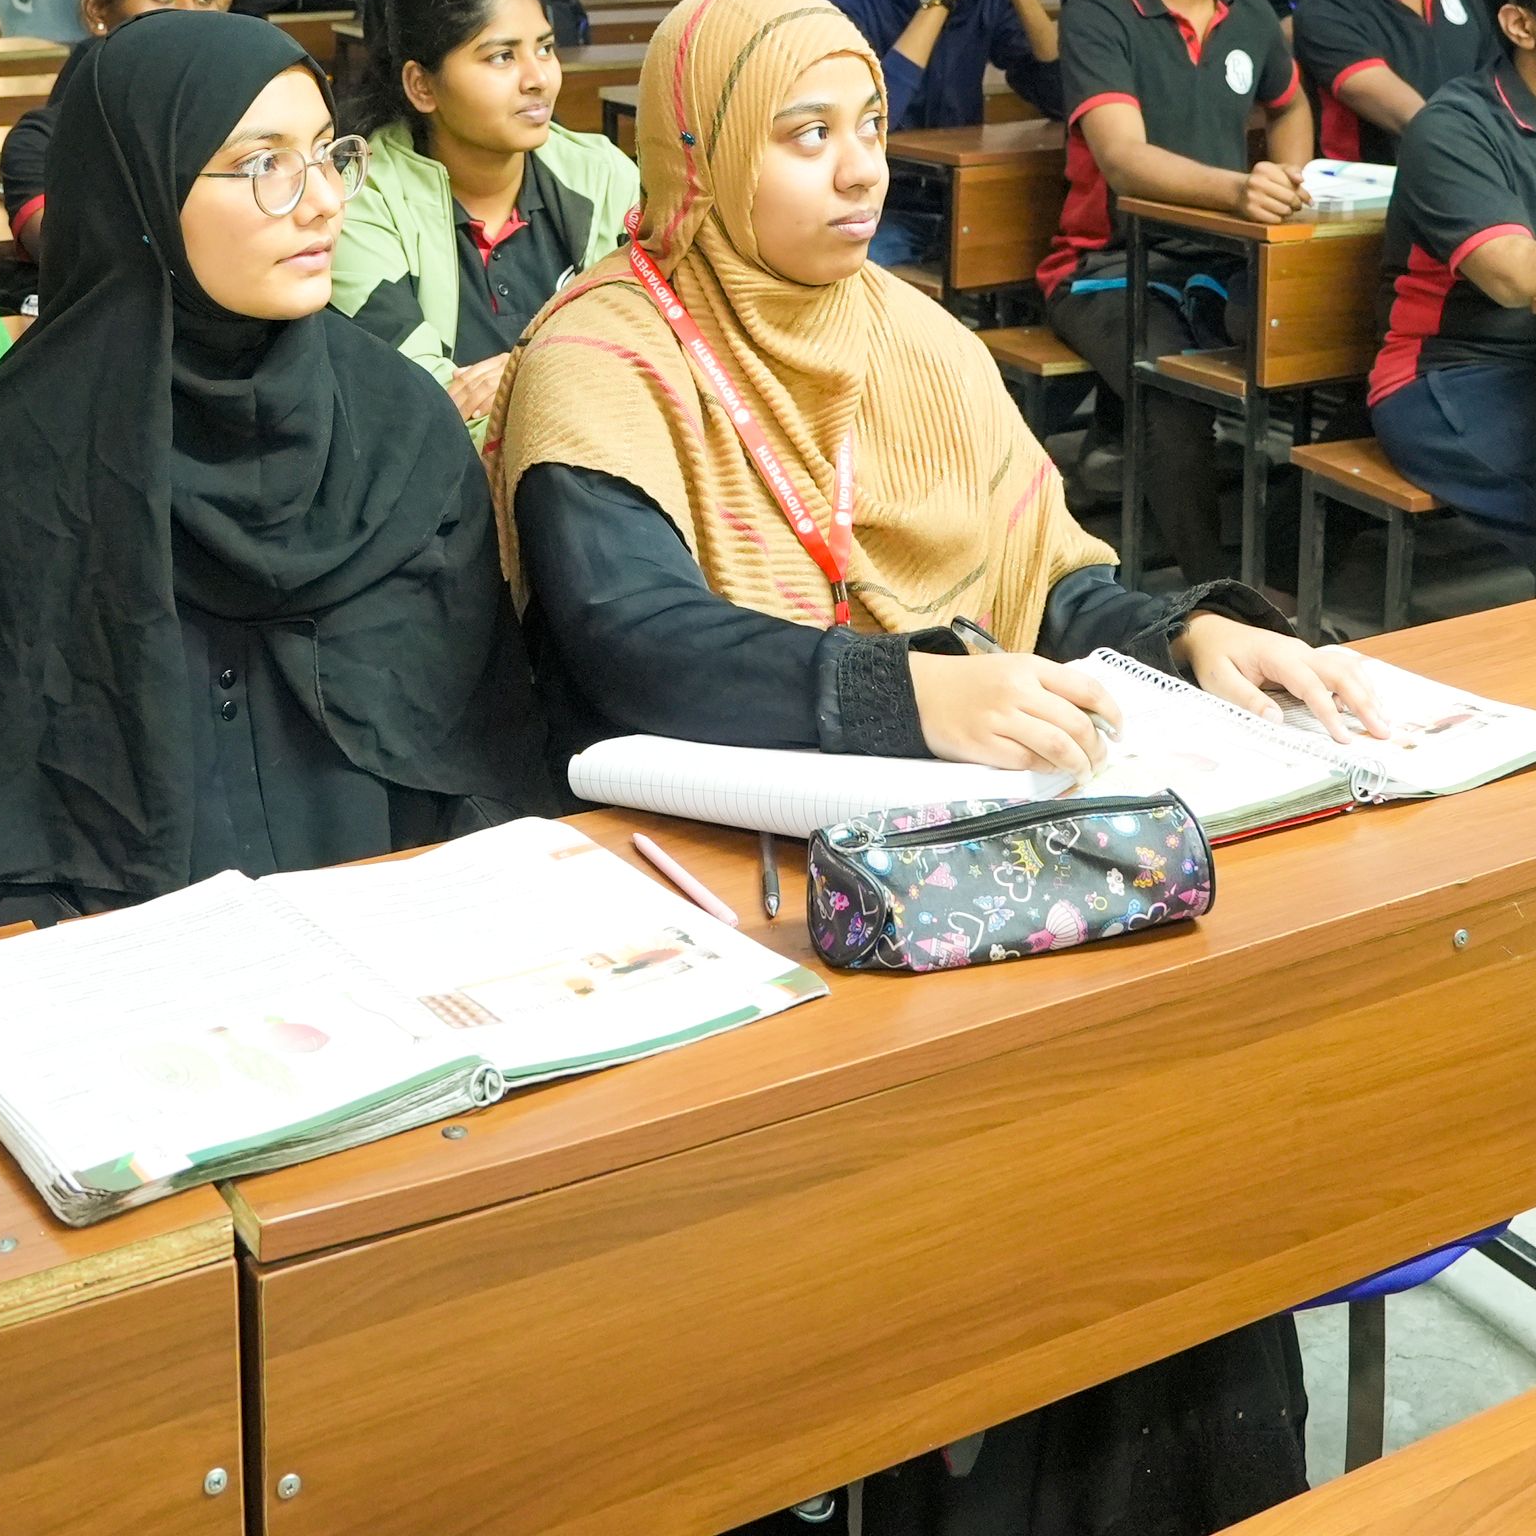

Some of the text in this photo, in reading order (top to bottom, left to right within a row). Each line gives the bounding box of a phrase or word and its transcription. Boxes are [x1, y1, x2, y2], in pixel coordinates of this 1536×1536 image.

[630, 245, 676, 305] VIDYAPEETH
[690, 337, 742, 410] VIDYAPEETH
[756, 444, 805, 522] VIDYAPEETH
